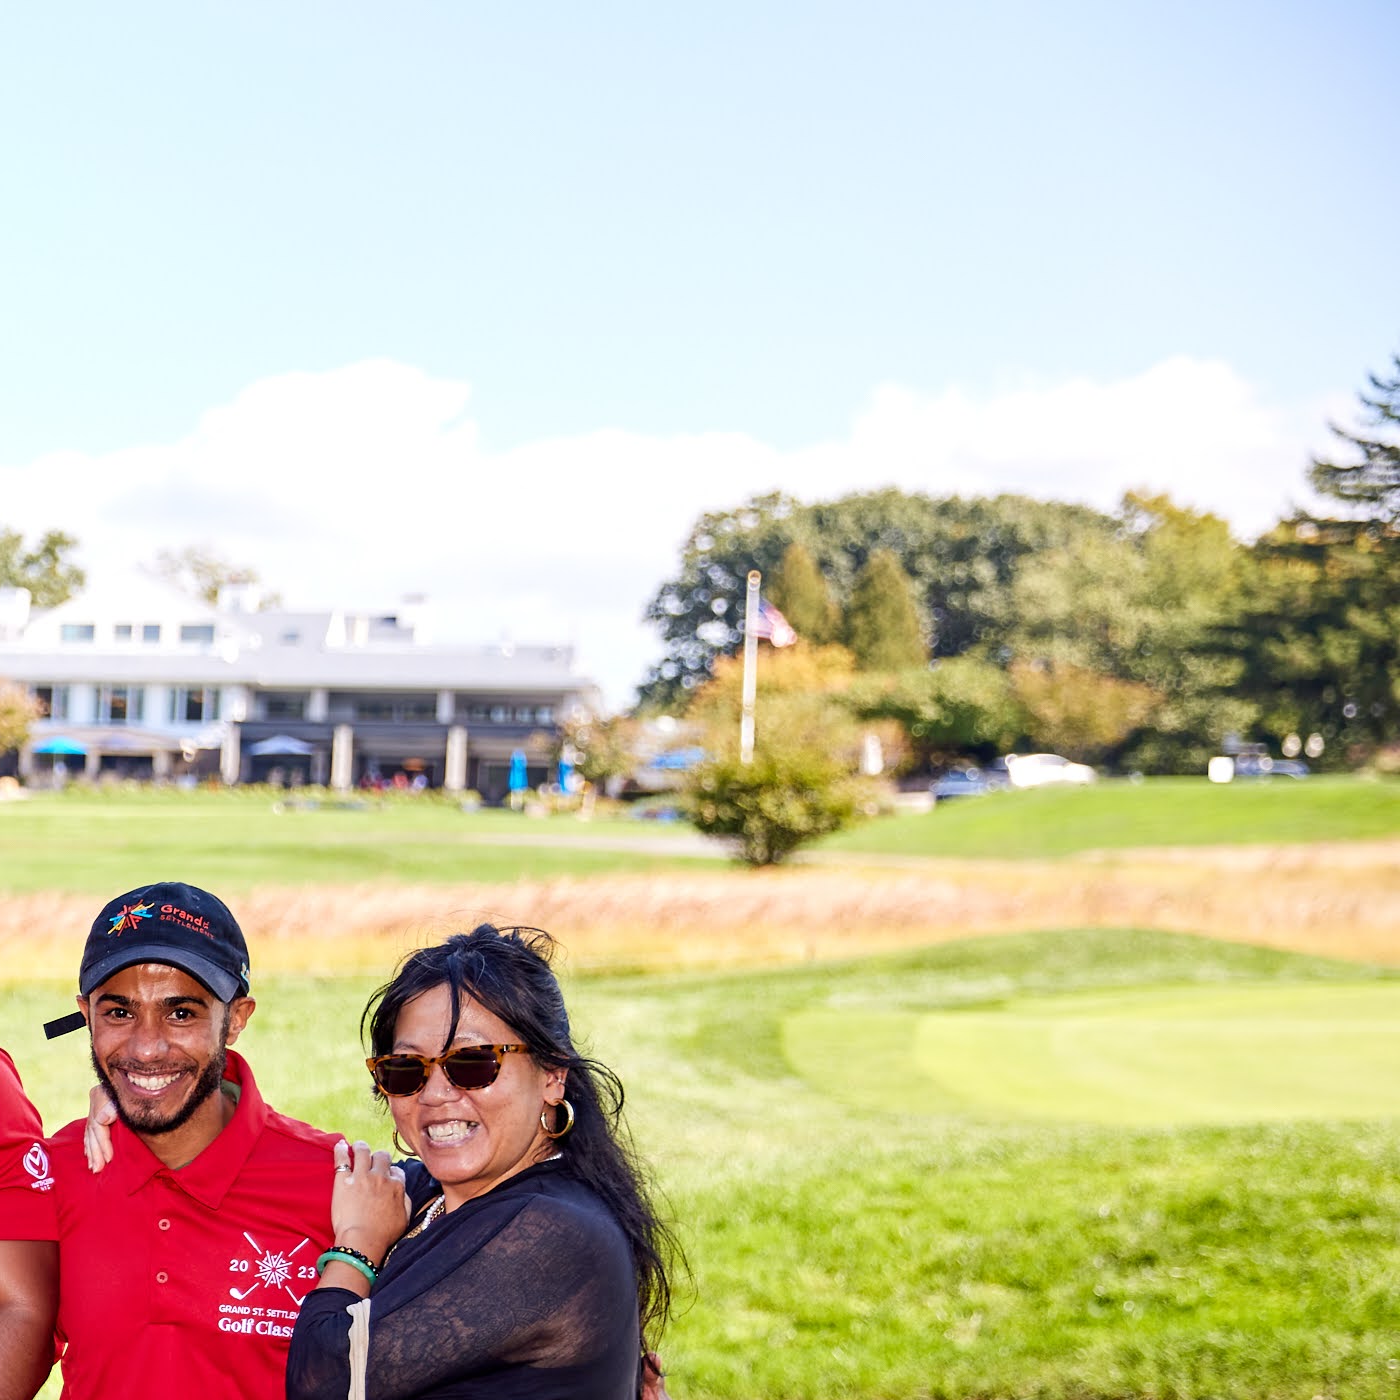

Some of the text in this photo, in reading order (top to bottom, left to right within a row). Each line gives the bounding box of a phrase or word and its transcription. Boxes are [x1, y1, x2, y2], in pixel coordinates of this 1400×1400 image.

[160, 914, 216, 940] SETTLEMENT
[229, 1259, 316, 1279] 20 23
[219, 1304, 300, 1320] GRAND ST. SETTLE
[218, 1317, 294, 1338] Golf Clas
